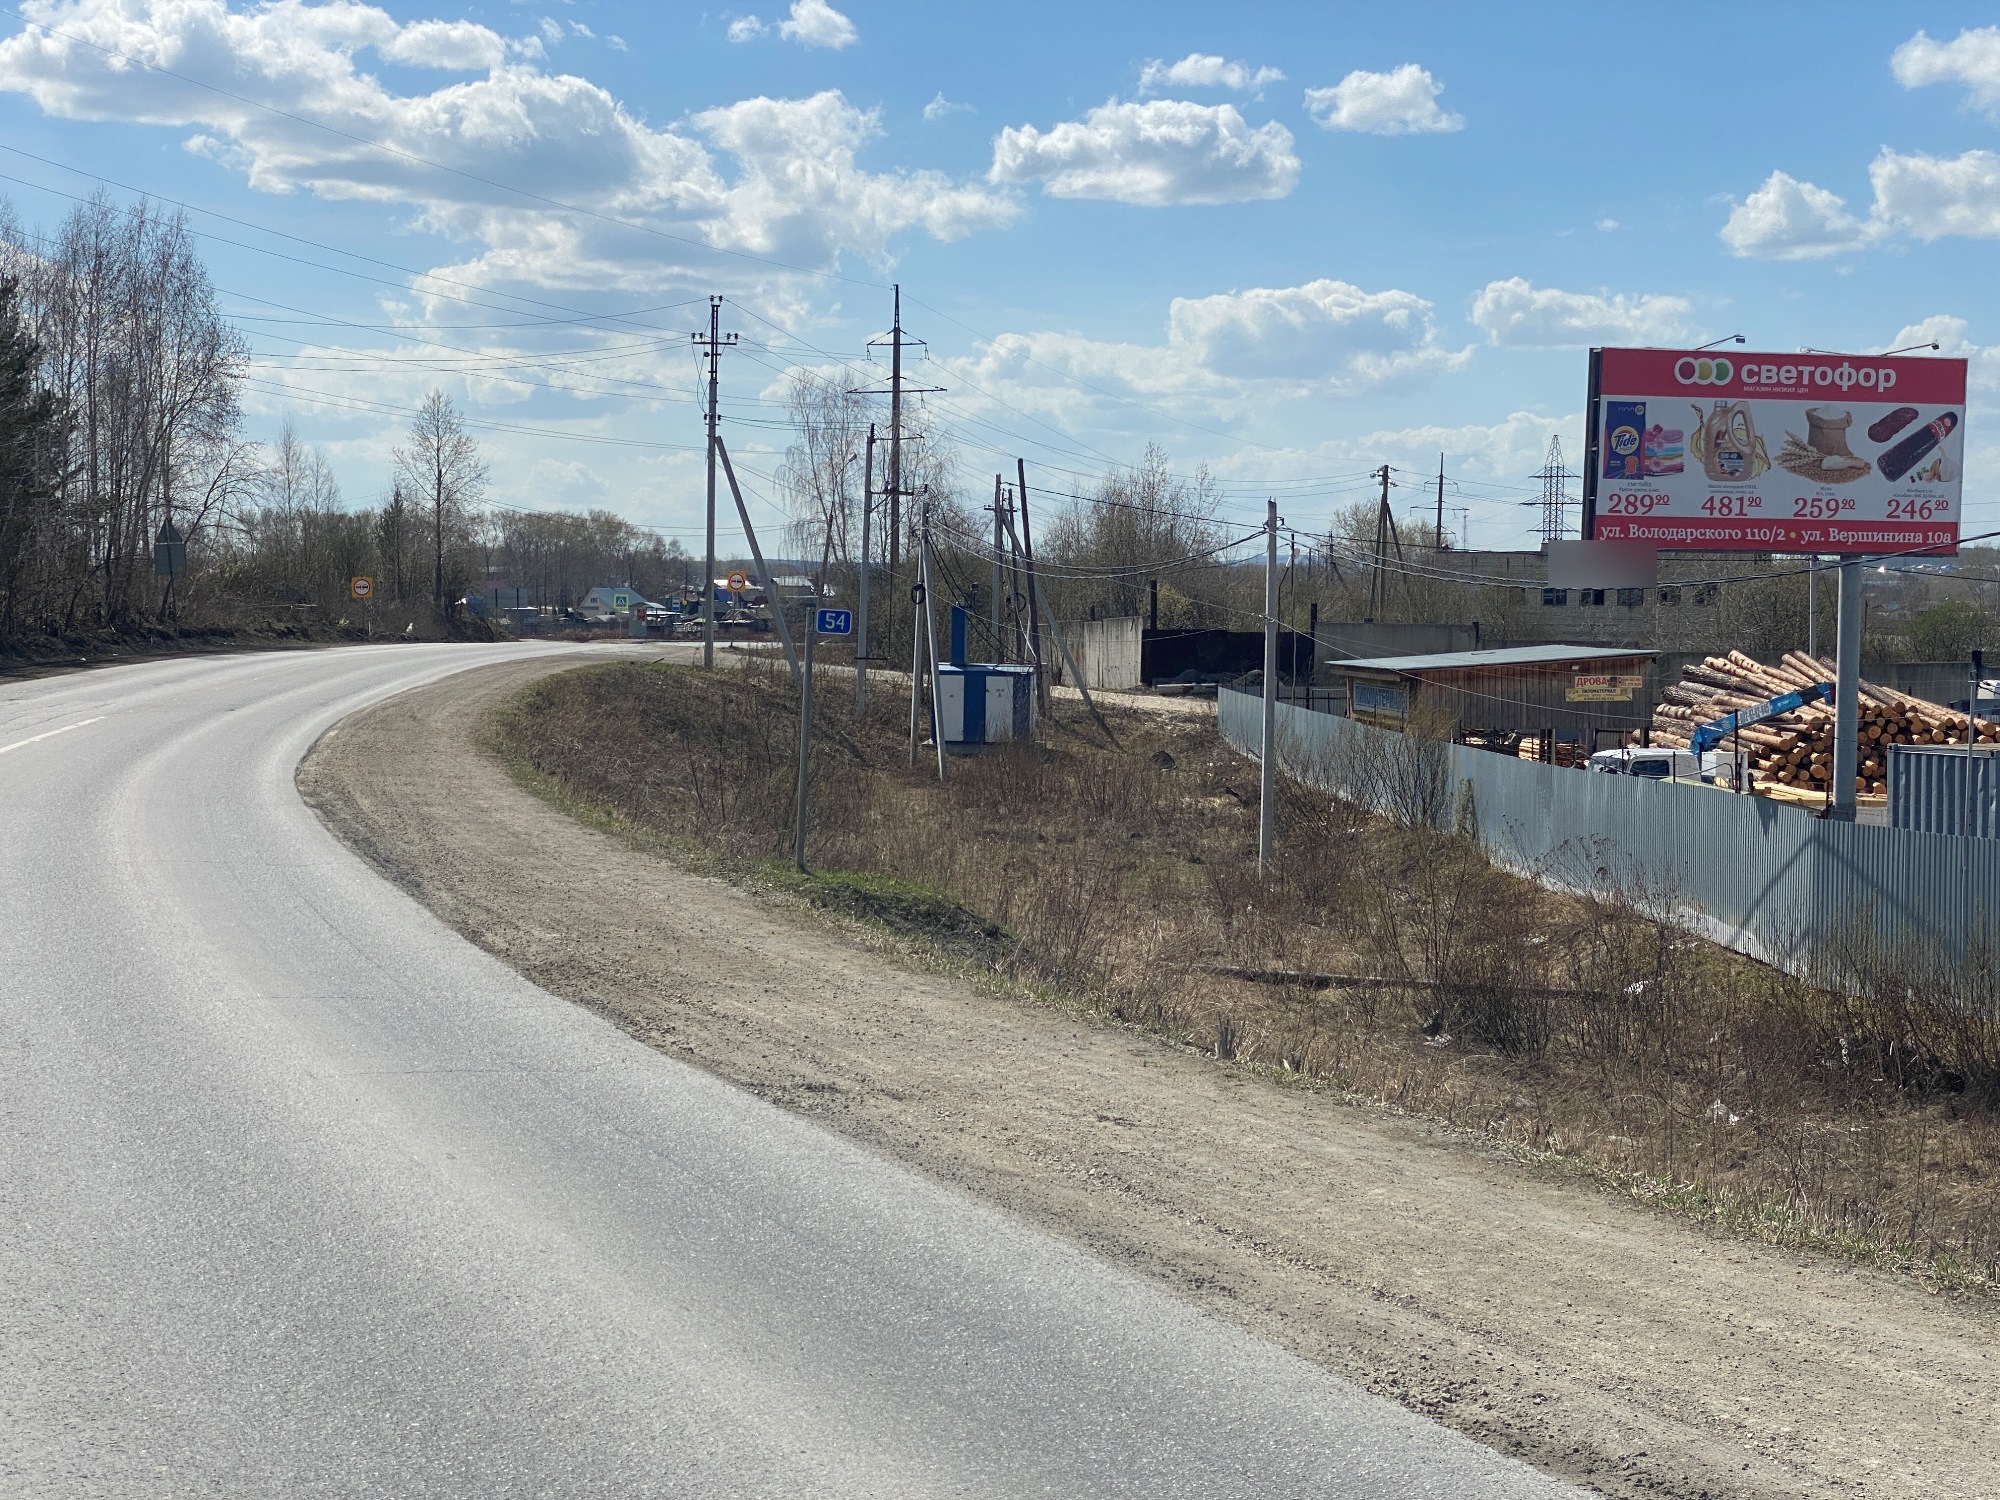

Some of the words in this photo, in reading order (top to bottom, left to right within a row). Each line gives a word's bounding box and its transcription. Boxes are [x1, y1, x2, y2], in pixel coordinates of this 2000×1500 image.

[1740, 361, 1897, 393] светофор
[1613, 432, 1637, 451] Tide
[1607, 493, 1655, 515] 289
[1655, 494, 1670, 505] 90
[1700, 495, 1748, 517] 481
[1747, 496, 1762, 507] 90
[1792, 497, 1841, 519] 259
[1841, 498, 1856, 509] 90
[1885, 499, 1933, 521] 246
[1933, 500, 1949, 510] 90
[1600, 526, 1624, 541] ул.
[1628, 524, 1742, 542] Володарского
[1745, 527, 1786, 543] 110/2
[1800, 529, 1825, 545] ул.
[1828, 527, 1923, 545] Вершинина
[1926, 530, 1952, 544] 10а
[825, 612, 846, 630] 54
[1576, 677, 1608, 687] ДРОВА
